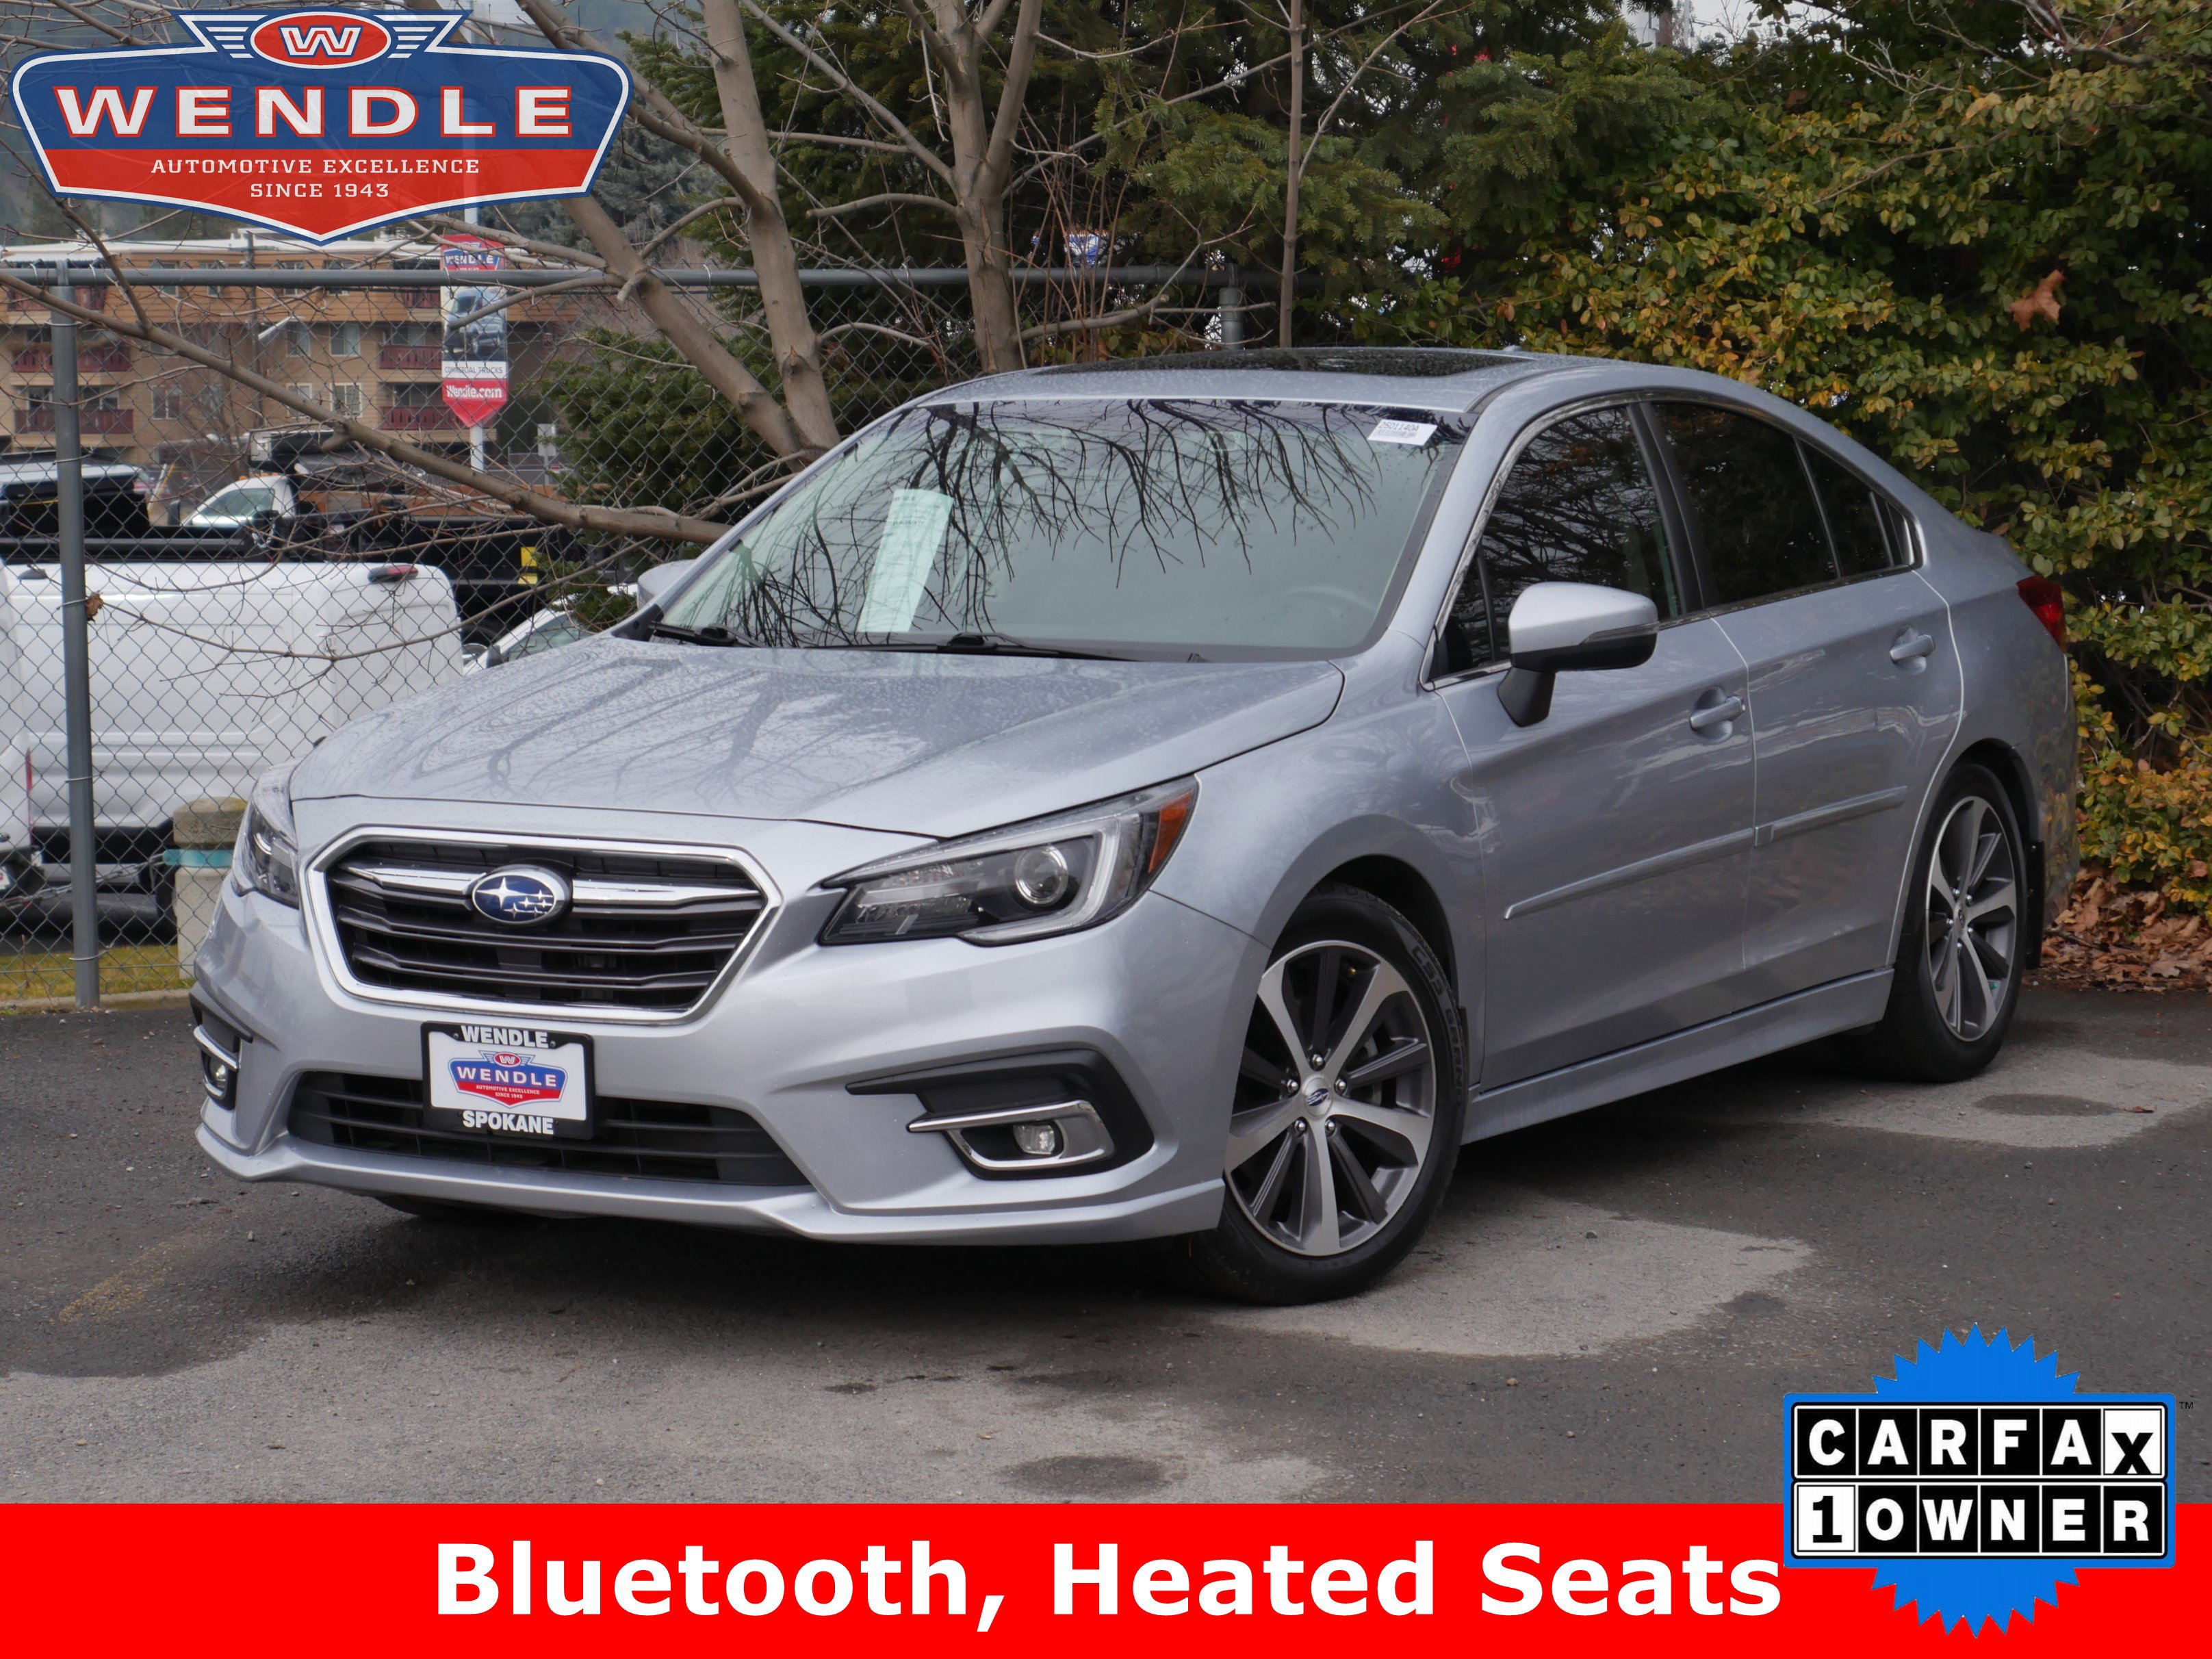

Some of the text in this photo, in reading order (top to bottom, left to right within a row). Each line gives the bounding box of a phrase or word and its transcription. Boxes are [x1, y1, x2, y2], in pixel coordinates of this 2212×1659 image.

[446, 385, 502, 398] Wendle.com
[461, 1025, 549, 1049] WENDLE
[456, 1066, 556, 1087] WENDLE
[509, 1087, 540, 1095] EXCELLENCE
[463, 1110, 555, 1135] SPOKANE
